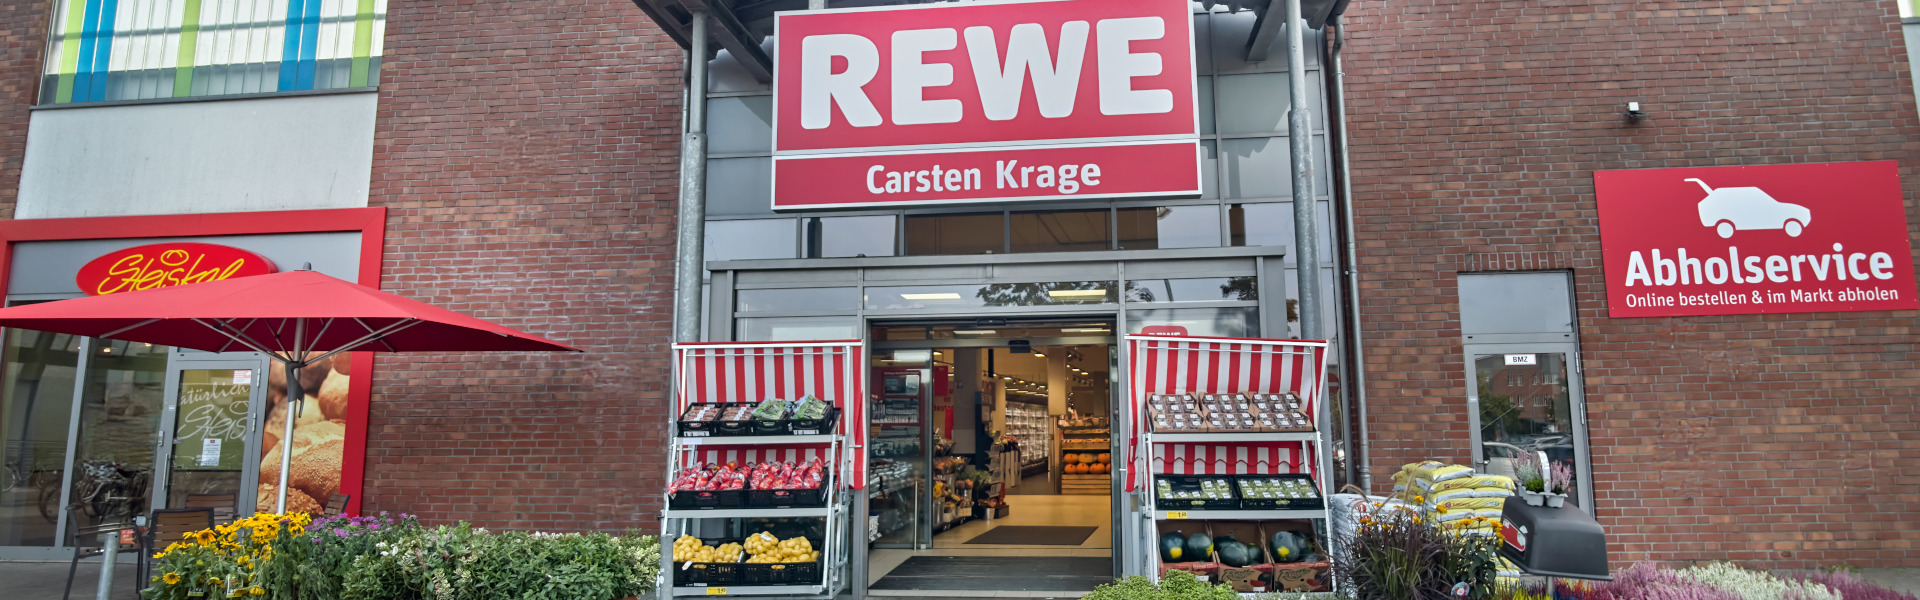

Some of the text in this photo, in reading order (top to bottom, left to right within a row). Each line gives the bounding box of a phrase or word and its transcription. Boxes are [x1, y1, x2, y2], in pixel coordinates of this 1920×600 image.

[801, 16, 1174, 130] REWE
[866, 159, 1101, 195] Carsten Krage
[1625, 242, 1894, 287] Abholservice
[1626, 286, 1899, 308] Online bestellen & im Markt abholen
[180, 382, 249, 405] atürlich
[177, 404, 248, 442] Steis
